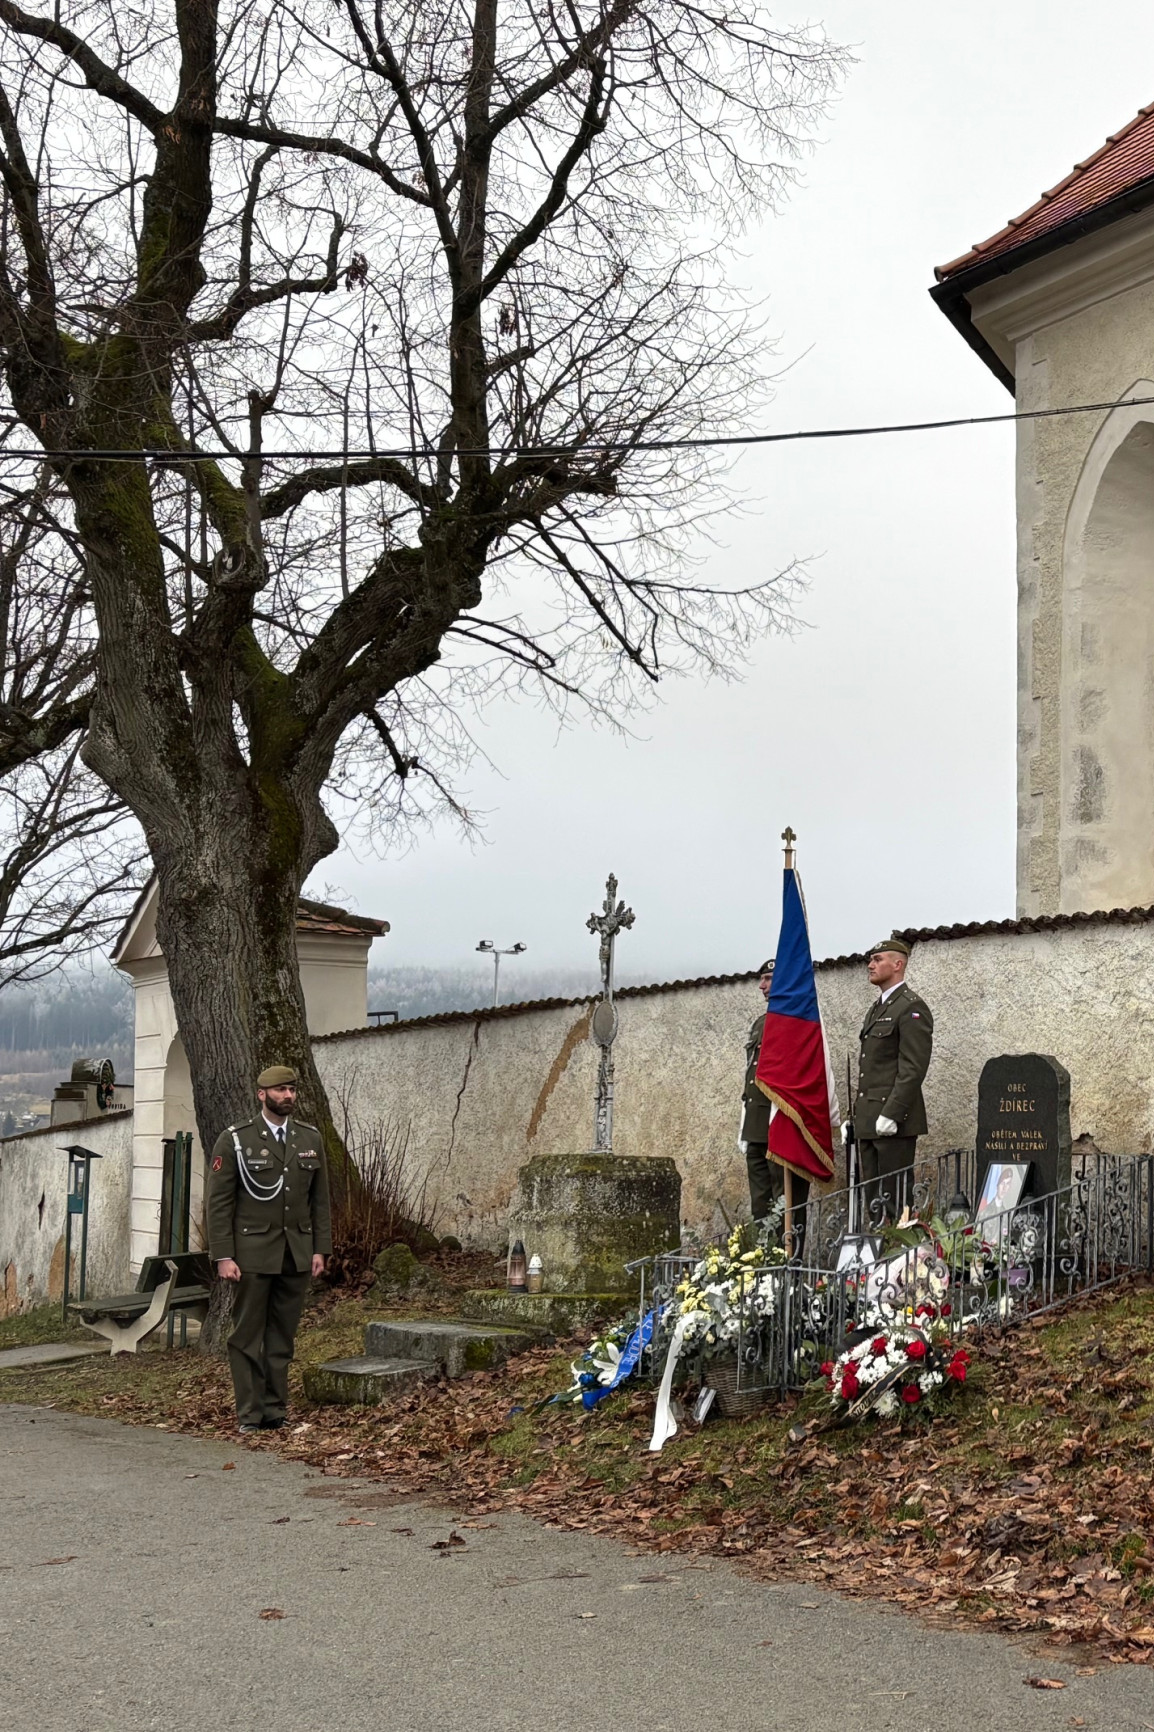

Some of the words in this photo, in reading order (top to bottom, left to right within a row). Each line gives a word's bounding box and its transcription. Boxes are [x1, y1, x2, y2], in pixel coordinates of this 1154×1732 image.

[1008, 1084, 1026, 1092] OBEC
[1000, 1097, 1035, 1112] ŽDÍREC
[992, 1129, 1017, 1138] OBĚTEM
[1021, 1128, 1042, 1138] VÁLEK
[1010, 1142, 1014, 1150] A
[1012, 1153, 1020, 1161] VE
